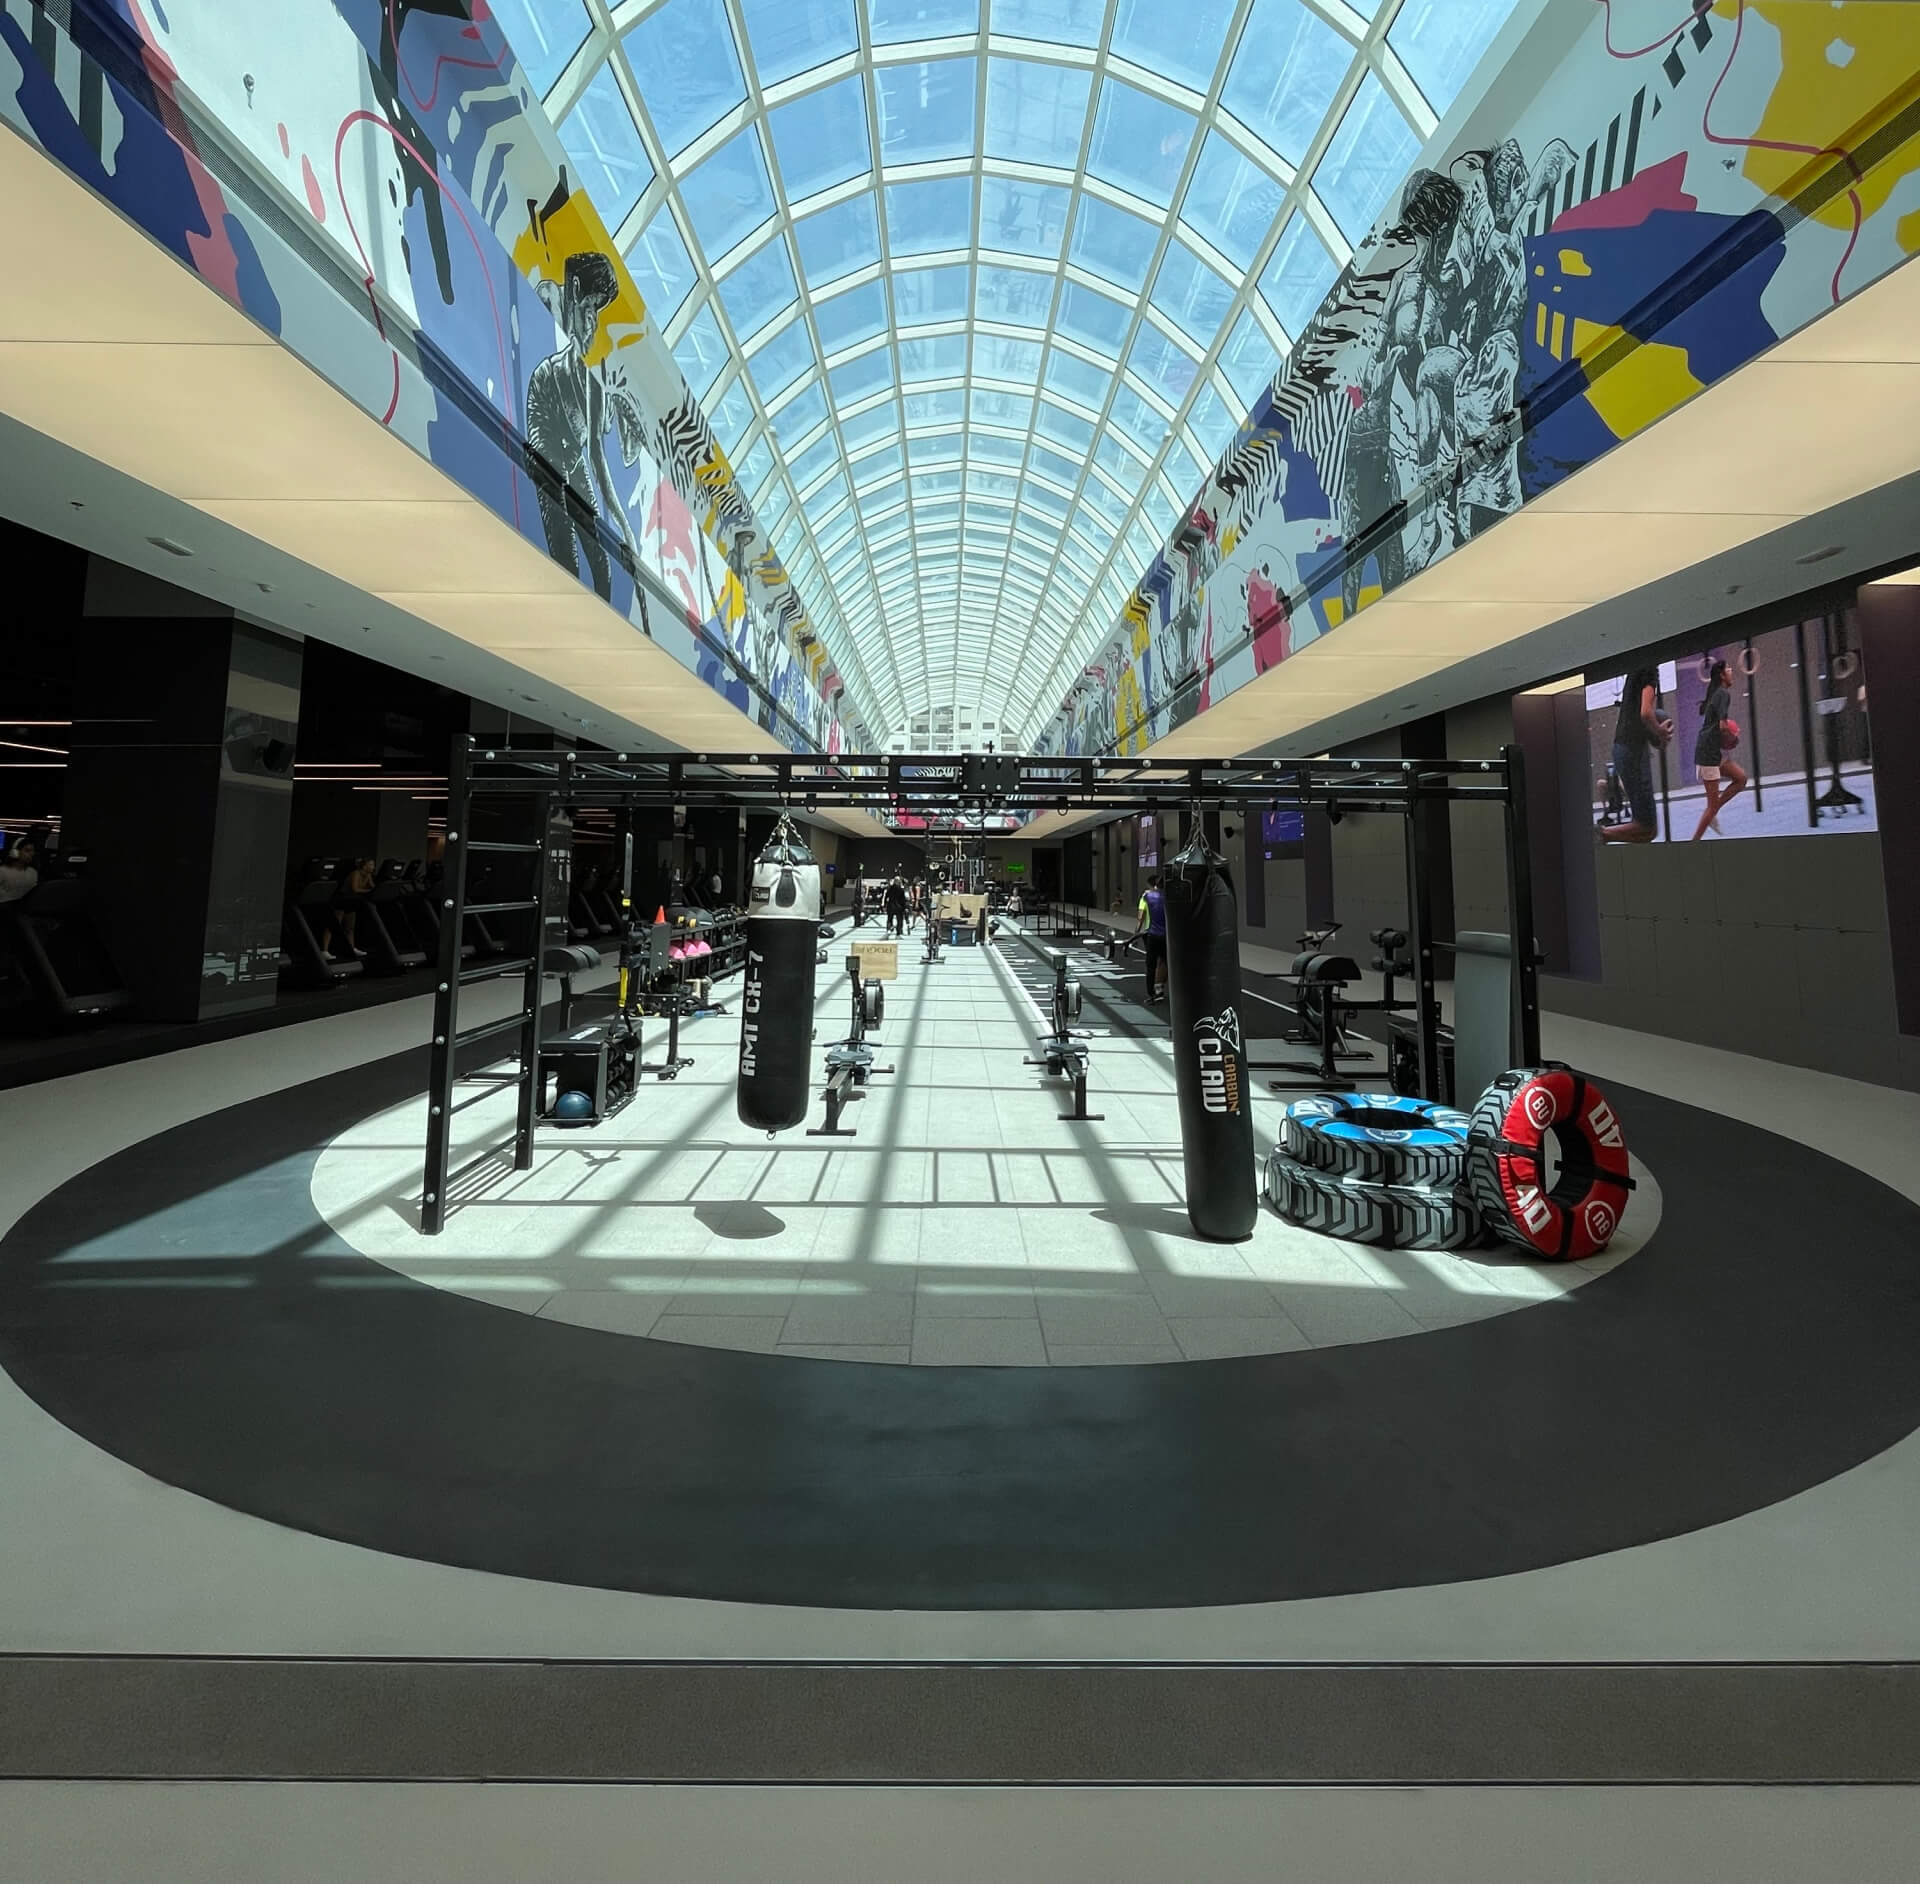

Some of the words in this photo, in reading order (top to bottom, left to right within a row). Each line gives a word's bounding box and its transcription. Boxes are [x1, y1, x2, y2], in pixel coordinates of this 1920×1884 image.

[741, 1020, 758, 1076] AMT
[1199, 1038, 1227, 1113] CLAW
[1224, 1054, 1238, 1112] CARBON
[1531, 1096, 1549, 1121] BU
[1592, 1211, 1611, 1233] BU
